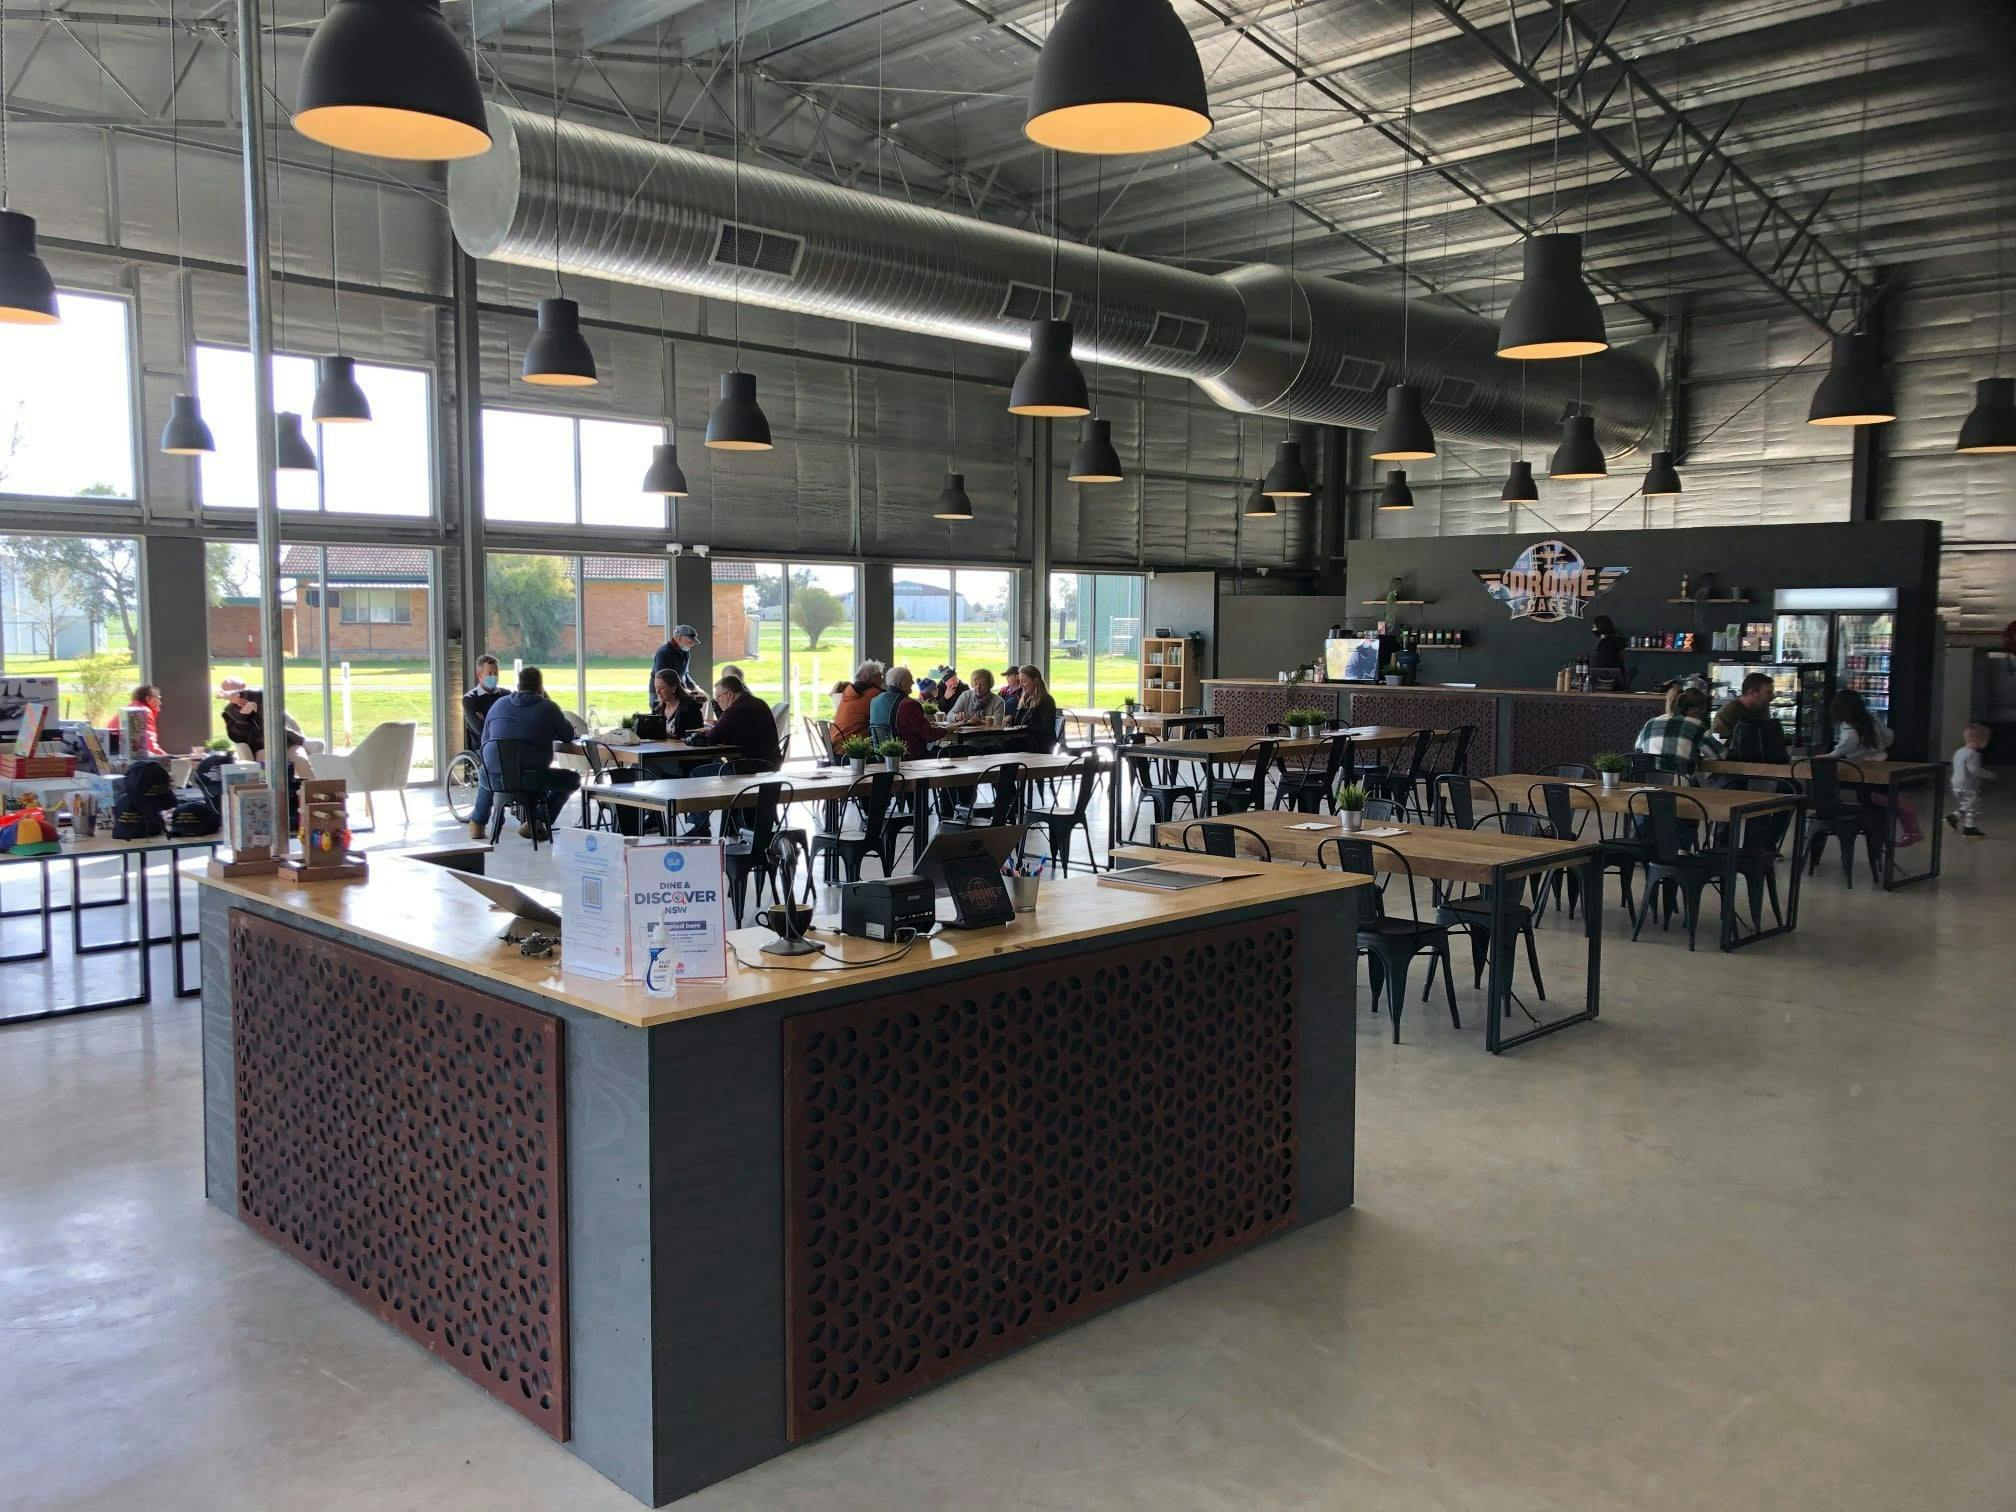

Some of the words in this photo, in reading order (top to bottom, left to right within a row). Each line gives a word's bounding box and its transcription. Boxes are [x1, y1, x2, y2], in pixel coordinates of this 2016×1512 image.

[660, 882, 682, 890] DINE
[684, 881, 690, 889] &
[634, 890, 717, 905] DISCOVER
[664, 906, 688, 914] NSW
